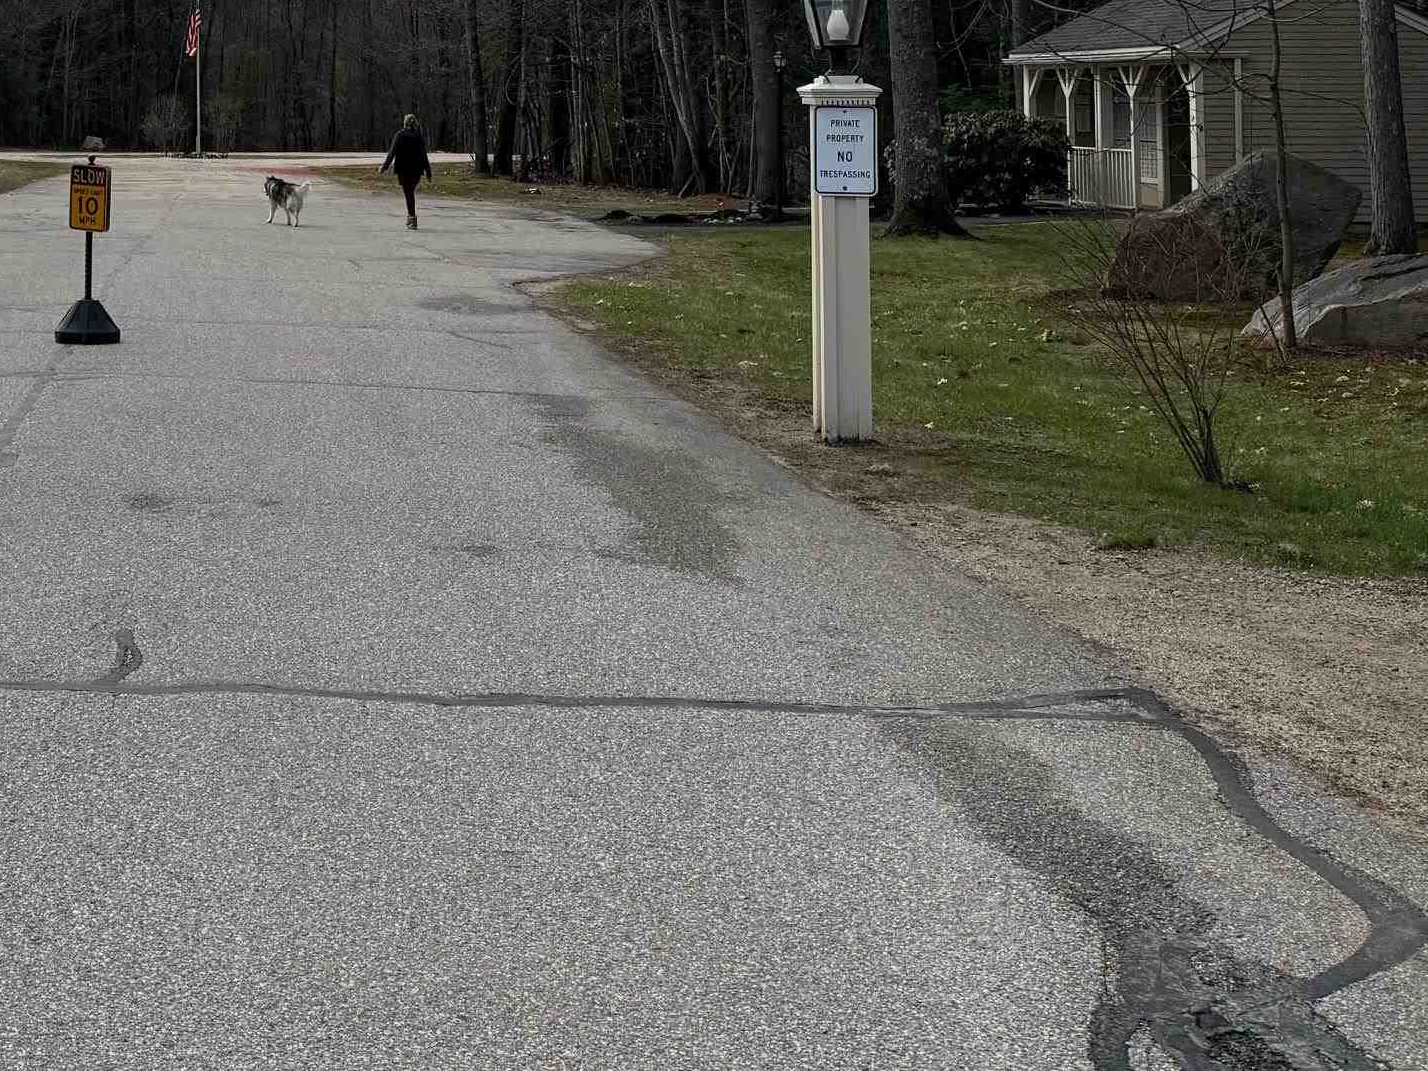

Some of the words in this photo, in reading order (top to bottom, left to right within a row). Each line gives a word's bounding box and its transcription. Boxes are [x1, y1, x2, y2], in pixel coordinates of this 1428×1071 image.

[830, 119, 860, 128] PRIVATE
[826, 134, 864, 143] PROPERTY
[837, 151, 853, 162] NO
[73, 169, 105, 184] SLOW
[820, 170, 871, 179] TRESPASSING
[78, 196, 98, 216] 10
